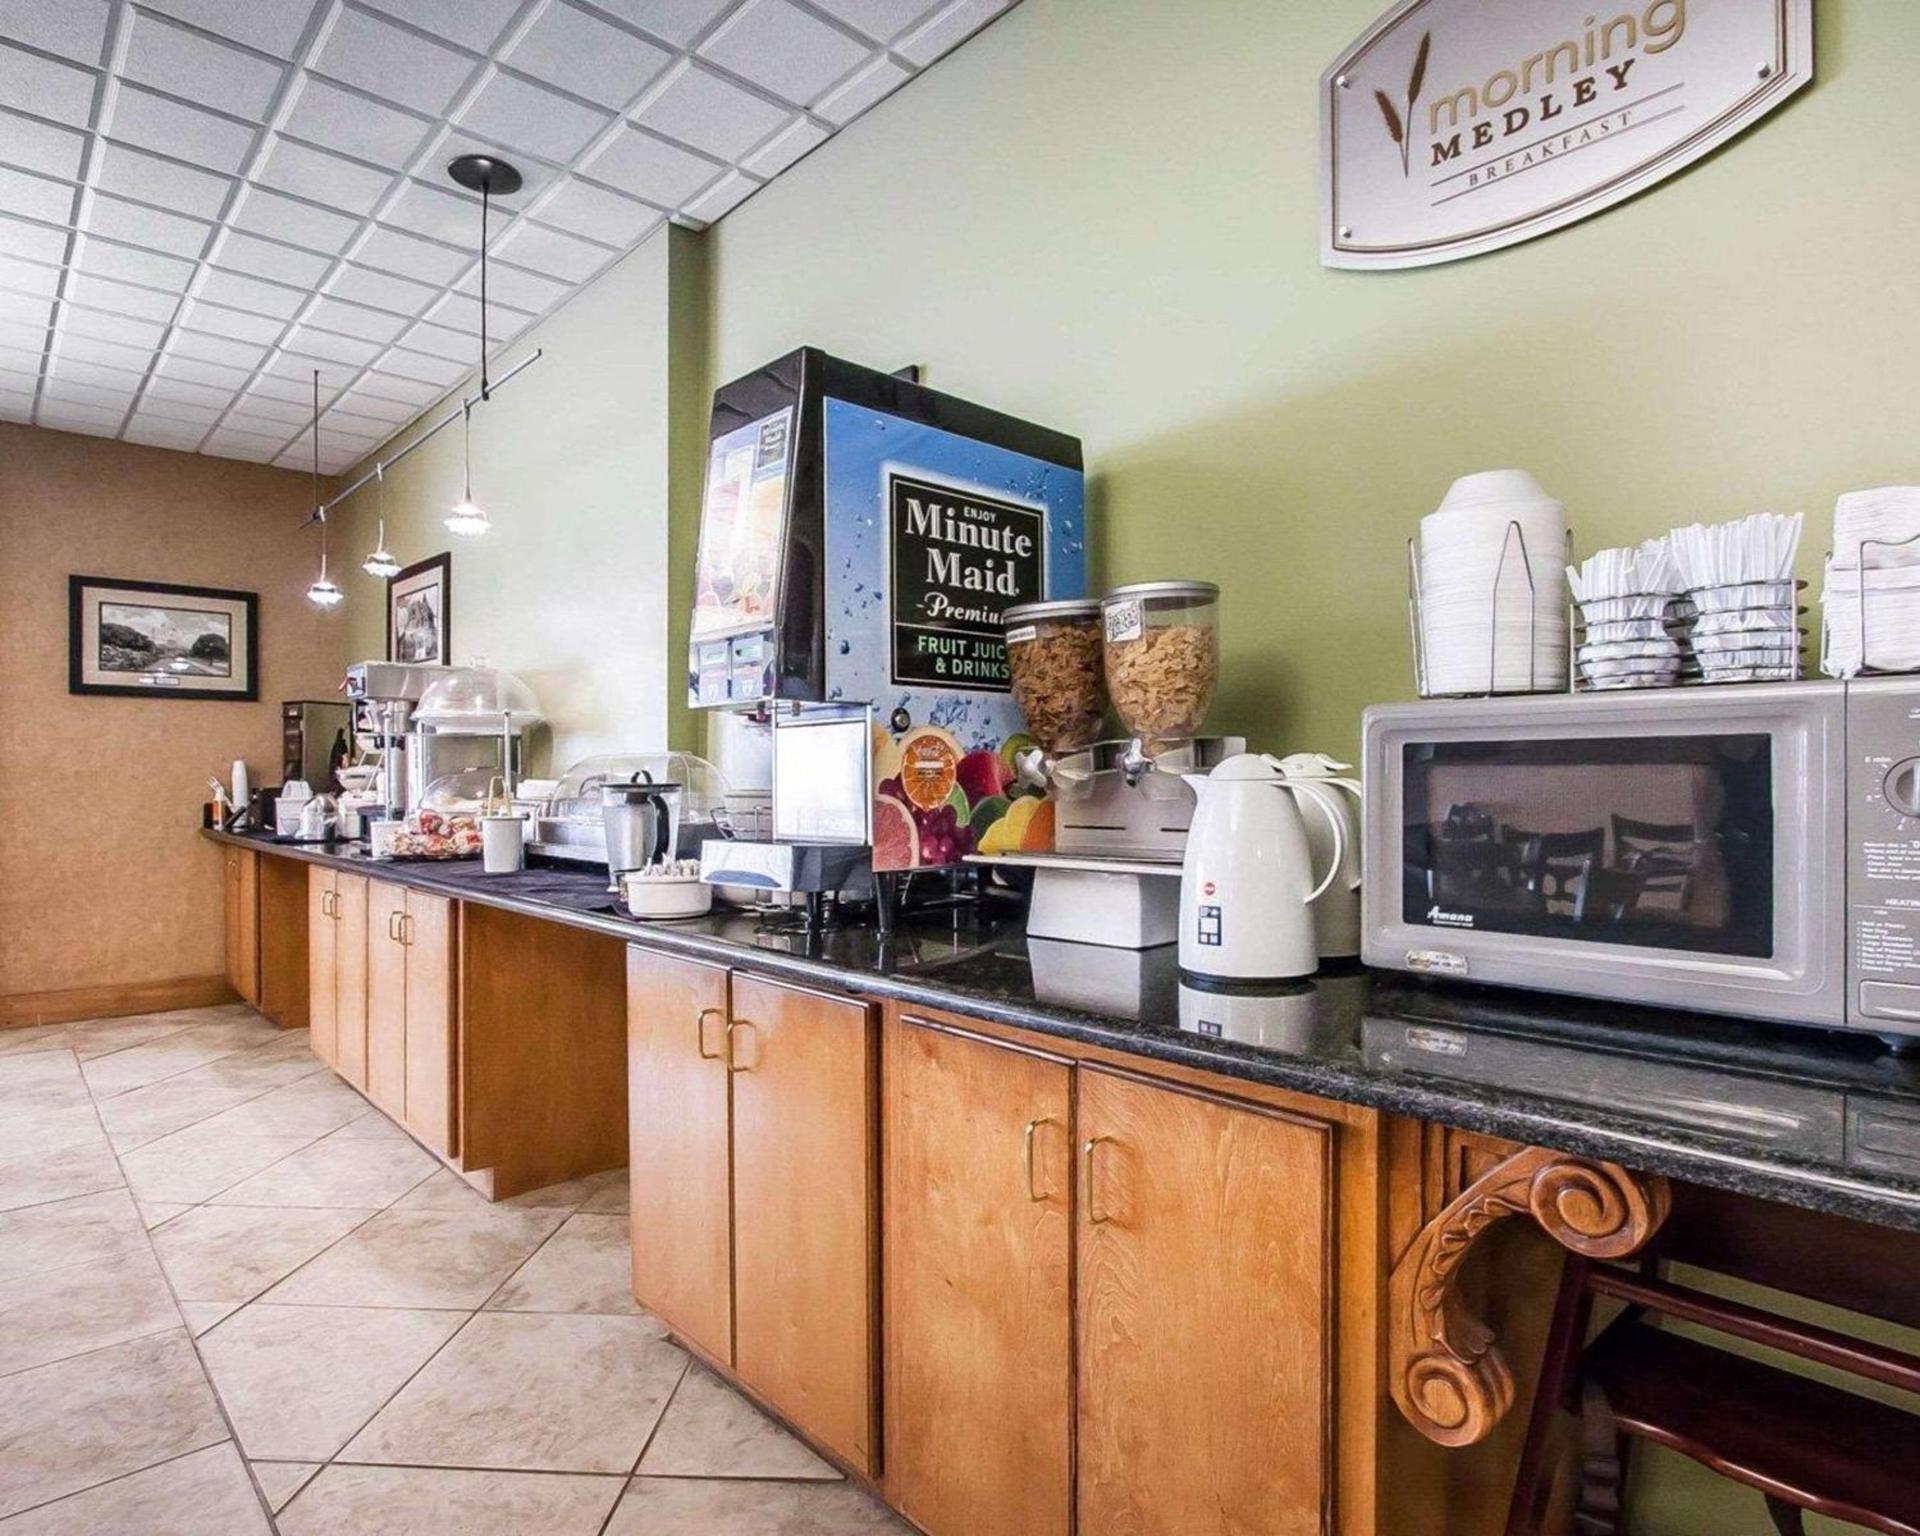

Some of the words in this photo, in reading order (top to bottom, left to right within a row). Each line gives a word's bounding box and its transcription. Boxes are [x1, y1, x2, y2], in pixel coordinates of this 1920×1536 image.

[1429, 0, 1686, 135] morning
[1430, 57, 1636, 167] MEDLEY
[1467, 110, 1633, 187] BREAKFAST
[904, 497, 1033, 558] Minute
[963, 506, 997, 523] ENJOY
[918, 635, 967, 657] FRUIT
[971, 641, 1006, 660] JUIC
[935, 656, 946, 674] &
[951, 658, 1010, 679] DRINKS
[1427, 905, 1474, 922] Amana
